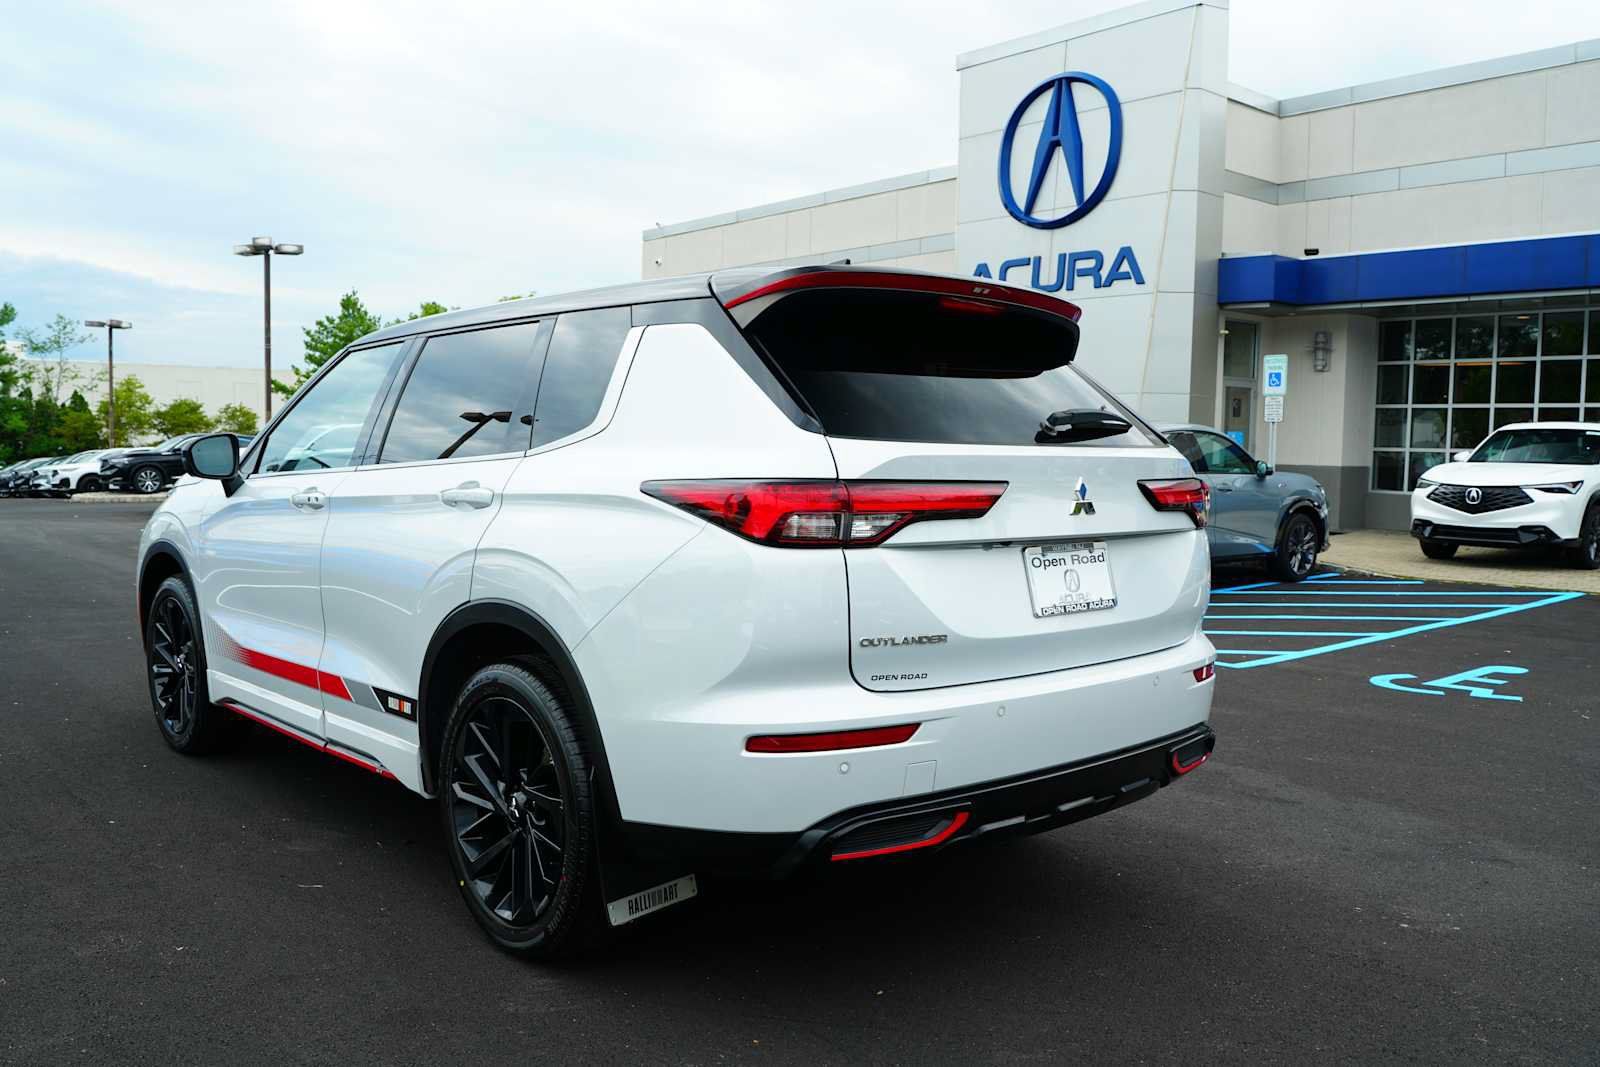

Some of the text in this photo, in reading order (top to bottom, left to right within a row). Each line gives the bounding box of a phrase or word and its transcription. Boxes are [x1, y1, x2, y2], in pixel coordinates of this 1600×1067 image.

[1031, 552, 1105, 570] Open Road
[1042, 599, 1114, 615] OPEN ROAD ACURA
[860, 634, 948, 648] OUTLANDER
[871, 673, 928, 681] OPEN ROAD
